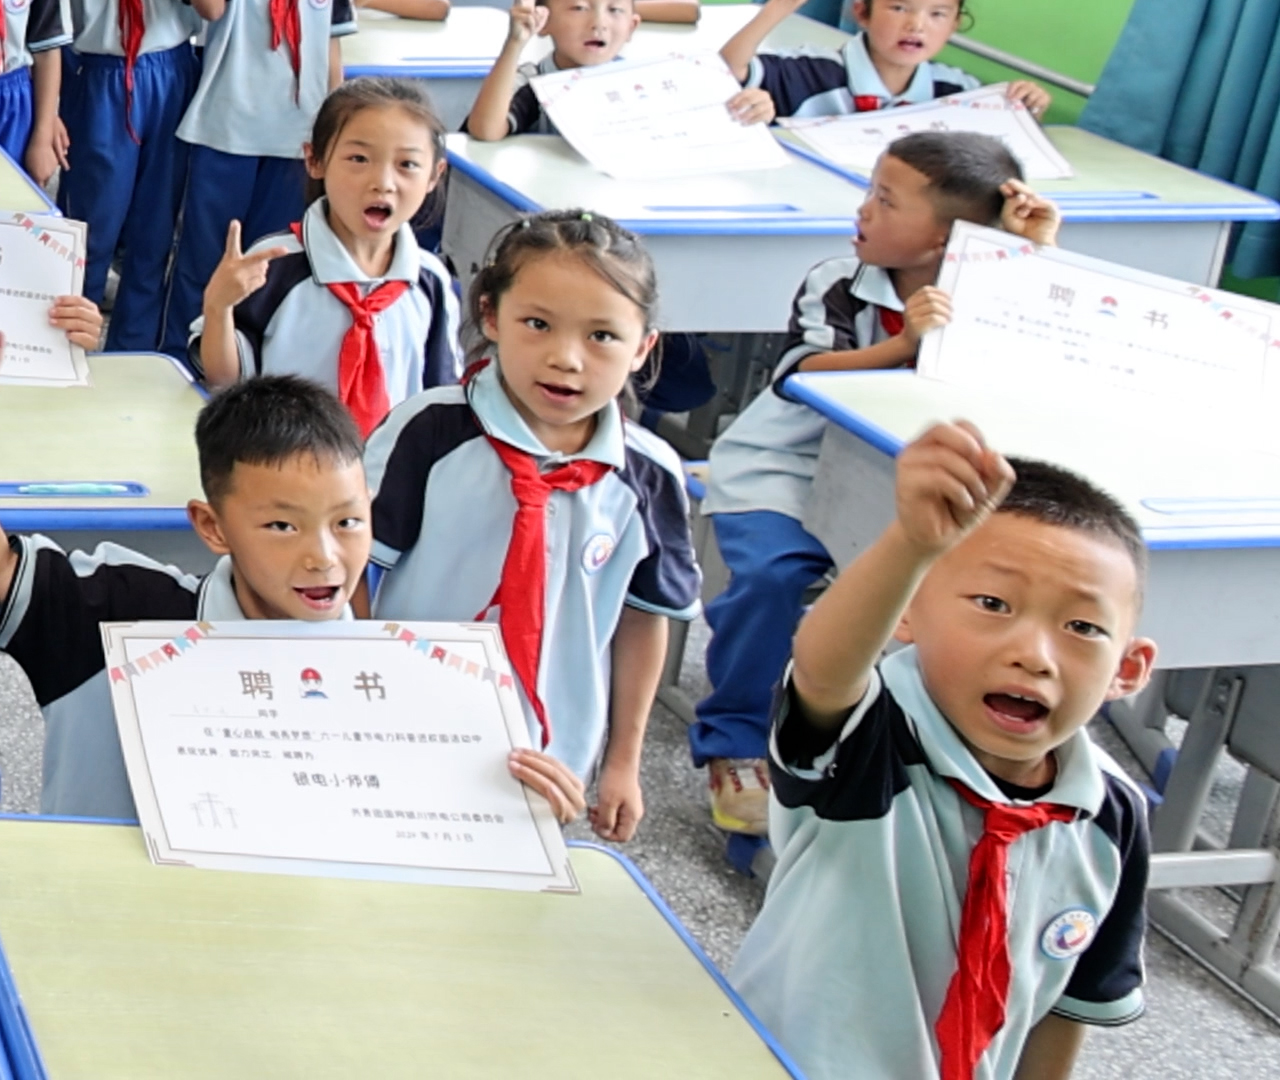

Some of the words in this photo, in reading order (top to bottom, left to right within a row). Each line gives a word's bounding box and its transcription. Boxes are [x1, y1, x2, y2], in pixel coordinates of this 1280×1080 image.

[1048, 283, 1076, 307] 聘
[1144, 310, 1169, 330] 书
[238, 669, 273, 701] 聘
[353, 671, 386, 702] 书
